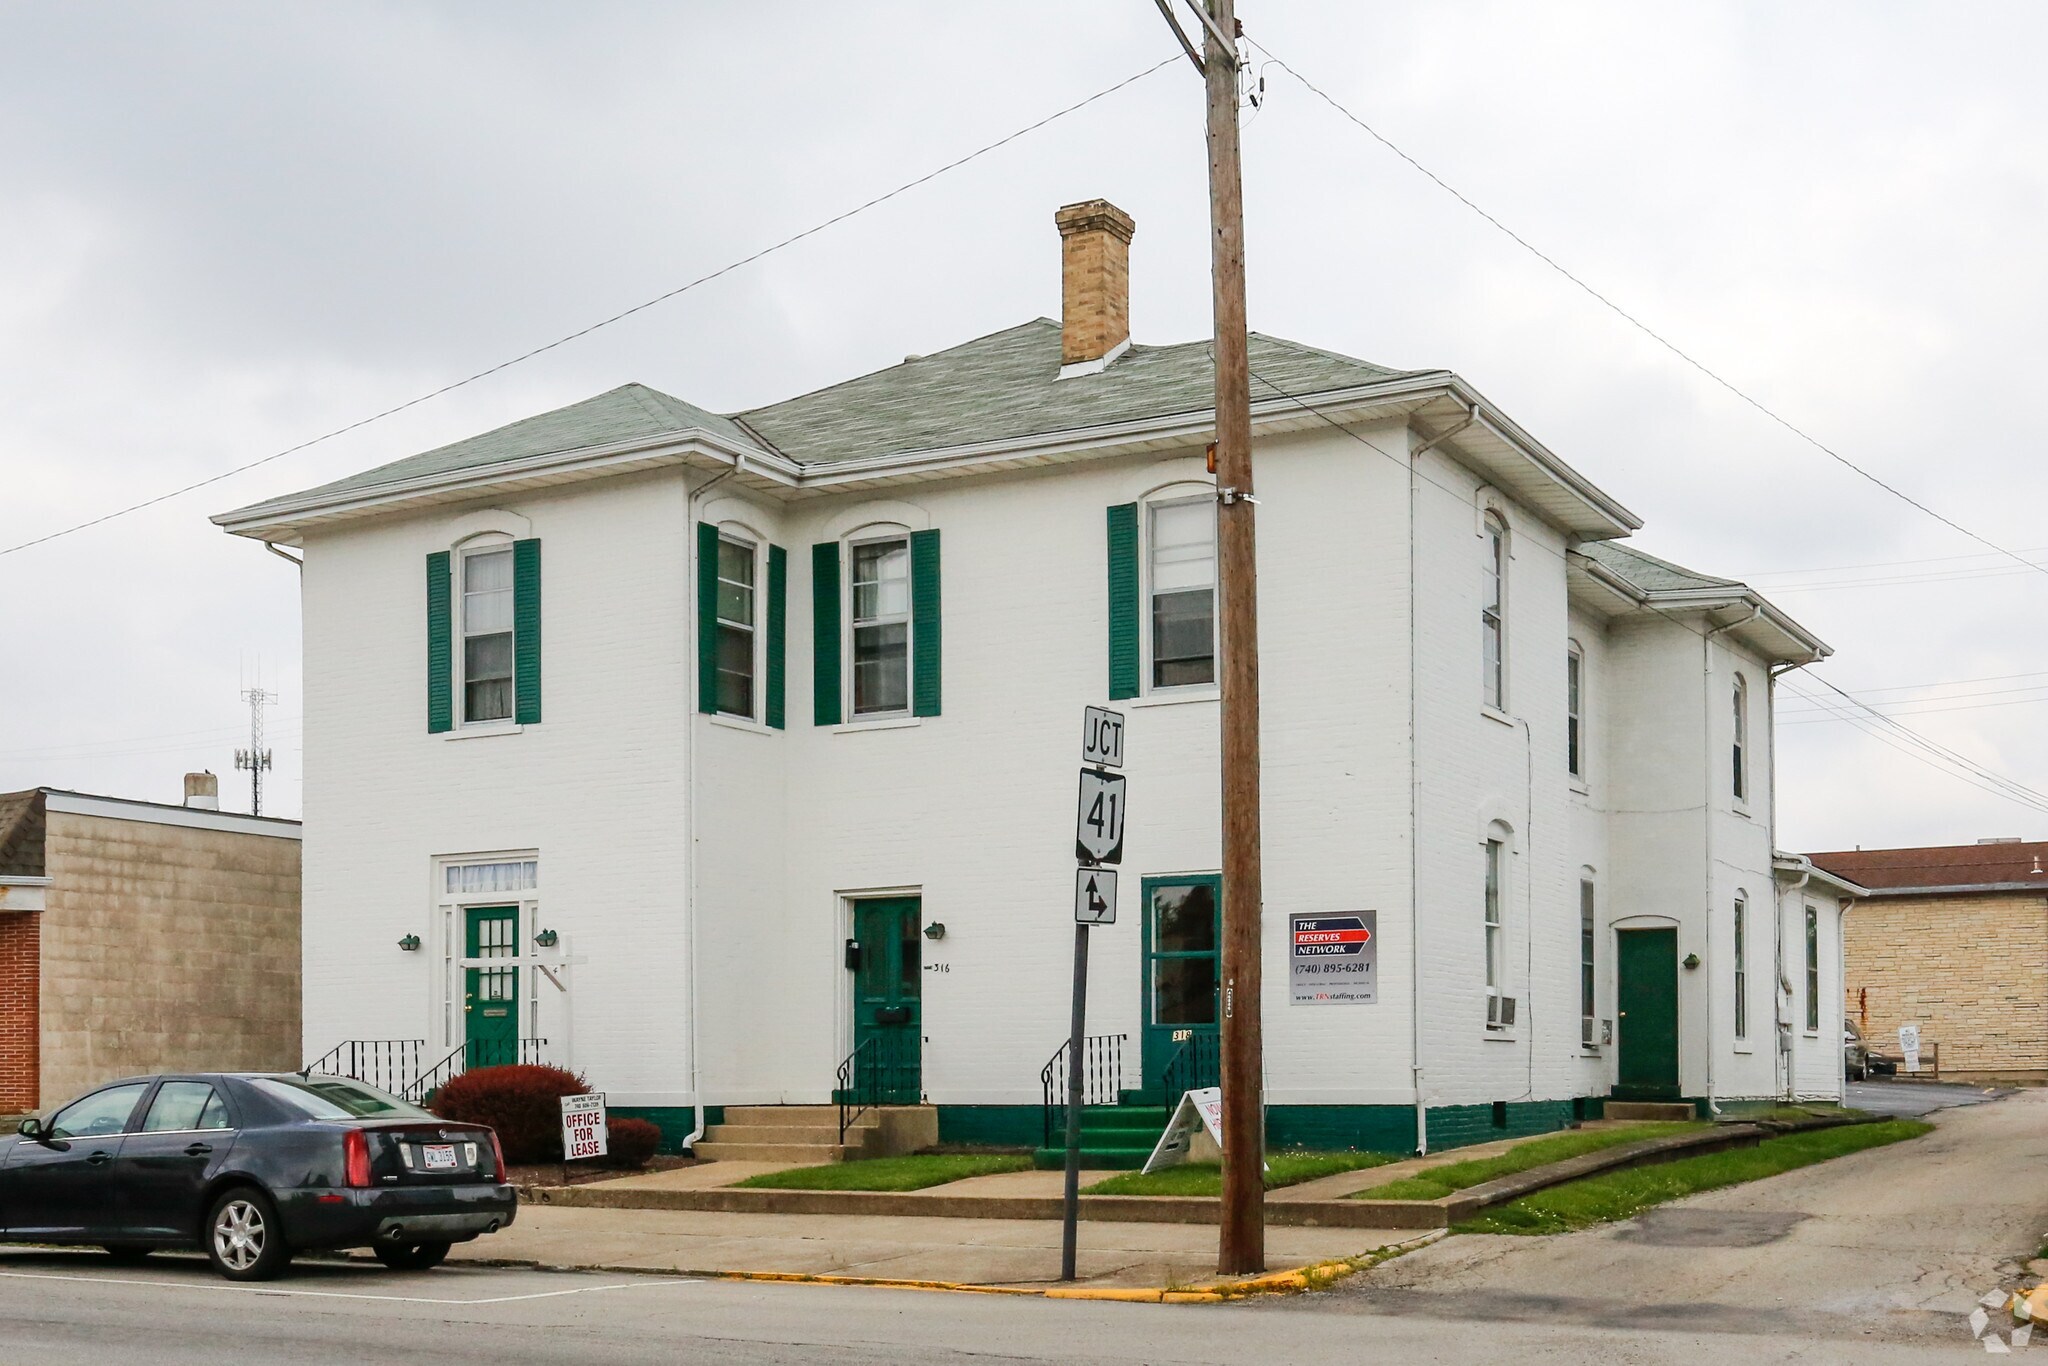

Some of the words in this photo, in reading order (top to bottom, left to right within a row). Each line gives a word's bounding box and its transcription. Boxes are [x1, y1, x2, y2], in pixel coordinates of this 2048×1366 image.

[1086, 717, 1122, 758] JCT
[1086, 791, 1117, 840] 41
[1298, 921, 1317, 930] THE
[1298, 932, 1341, 943] RESERVES
[1298, 944, 1347, 955] NETWORK
[933, 963, 950, 973] 316
[1295, 964, 1321, 975] (740)
[1323, 962, 1370, 974] 895-6281
[565, 1111, 601, 1128] OFFICE
[573, 1127, 594, 1142] FOR
[570, 1140, 600, 1157] LEASE
